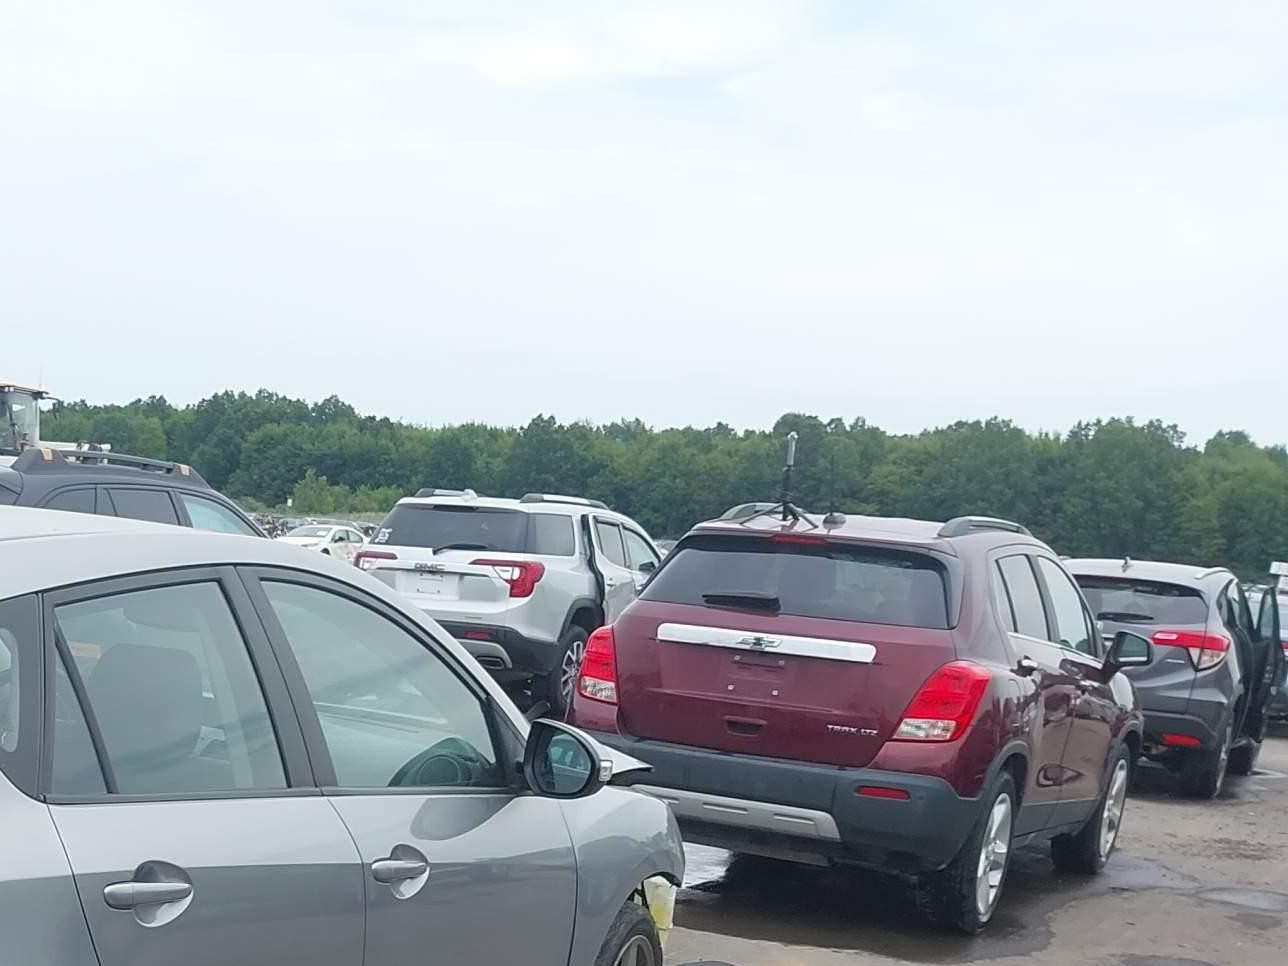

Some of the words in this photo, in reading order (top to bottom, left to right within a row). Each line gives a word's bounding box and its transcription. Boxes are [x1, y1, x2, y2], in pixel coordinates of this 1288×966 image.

[414, 562, 445, 572] GMC
[826, 724, 858, 736] TRAX
[860, 728, 878, 737] LTZ
